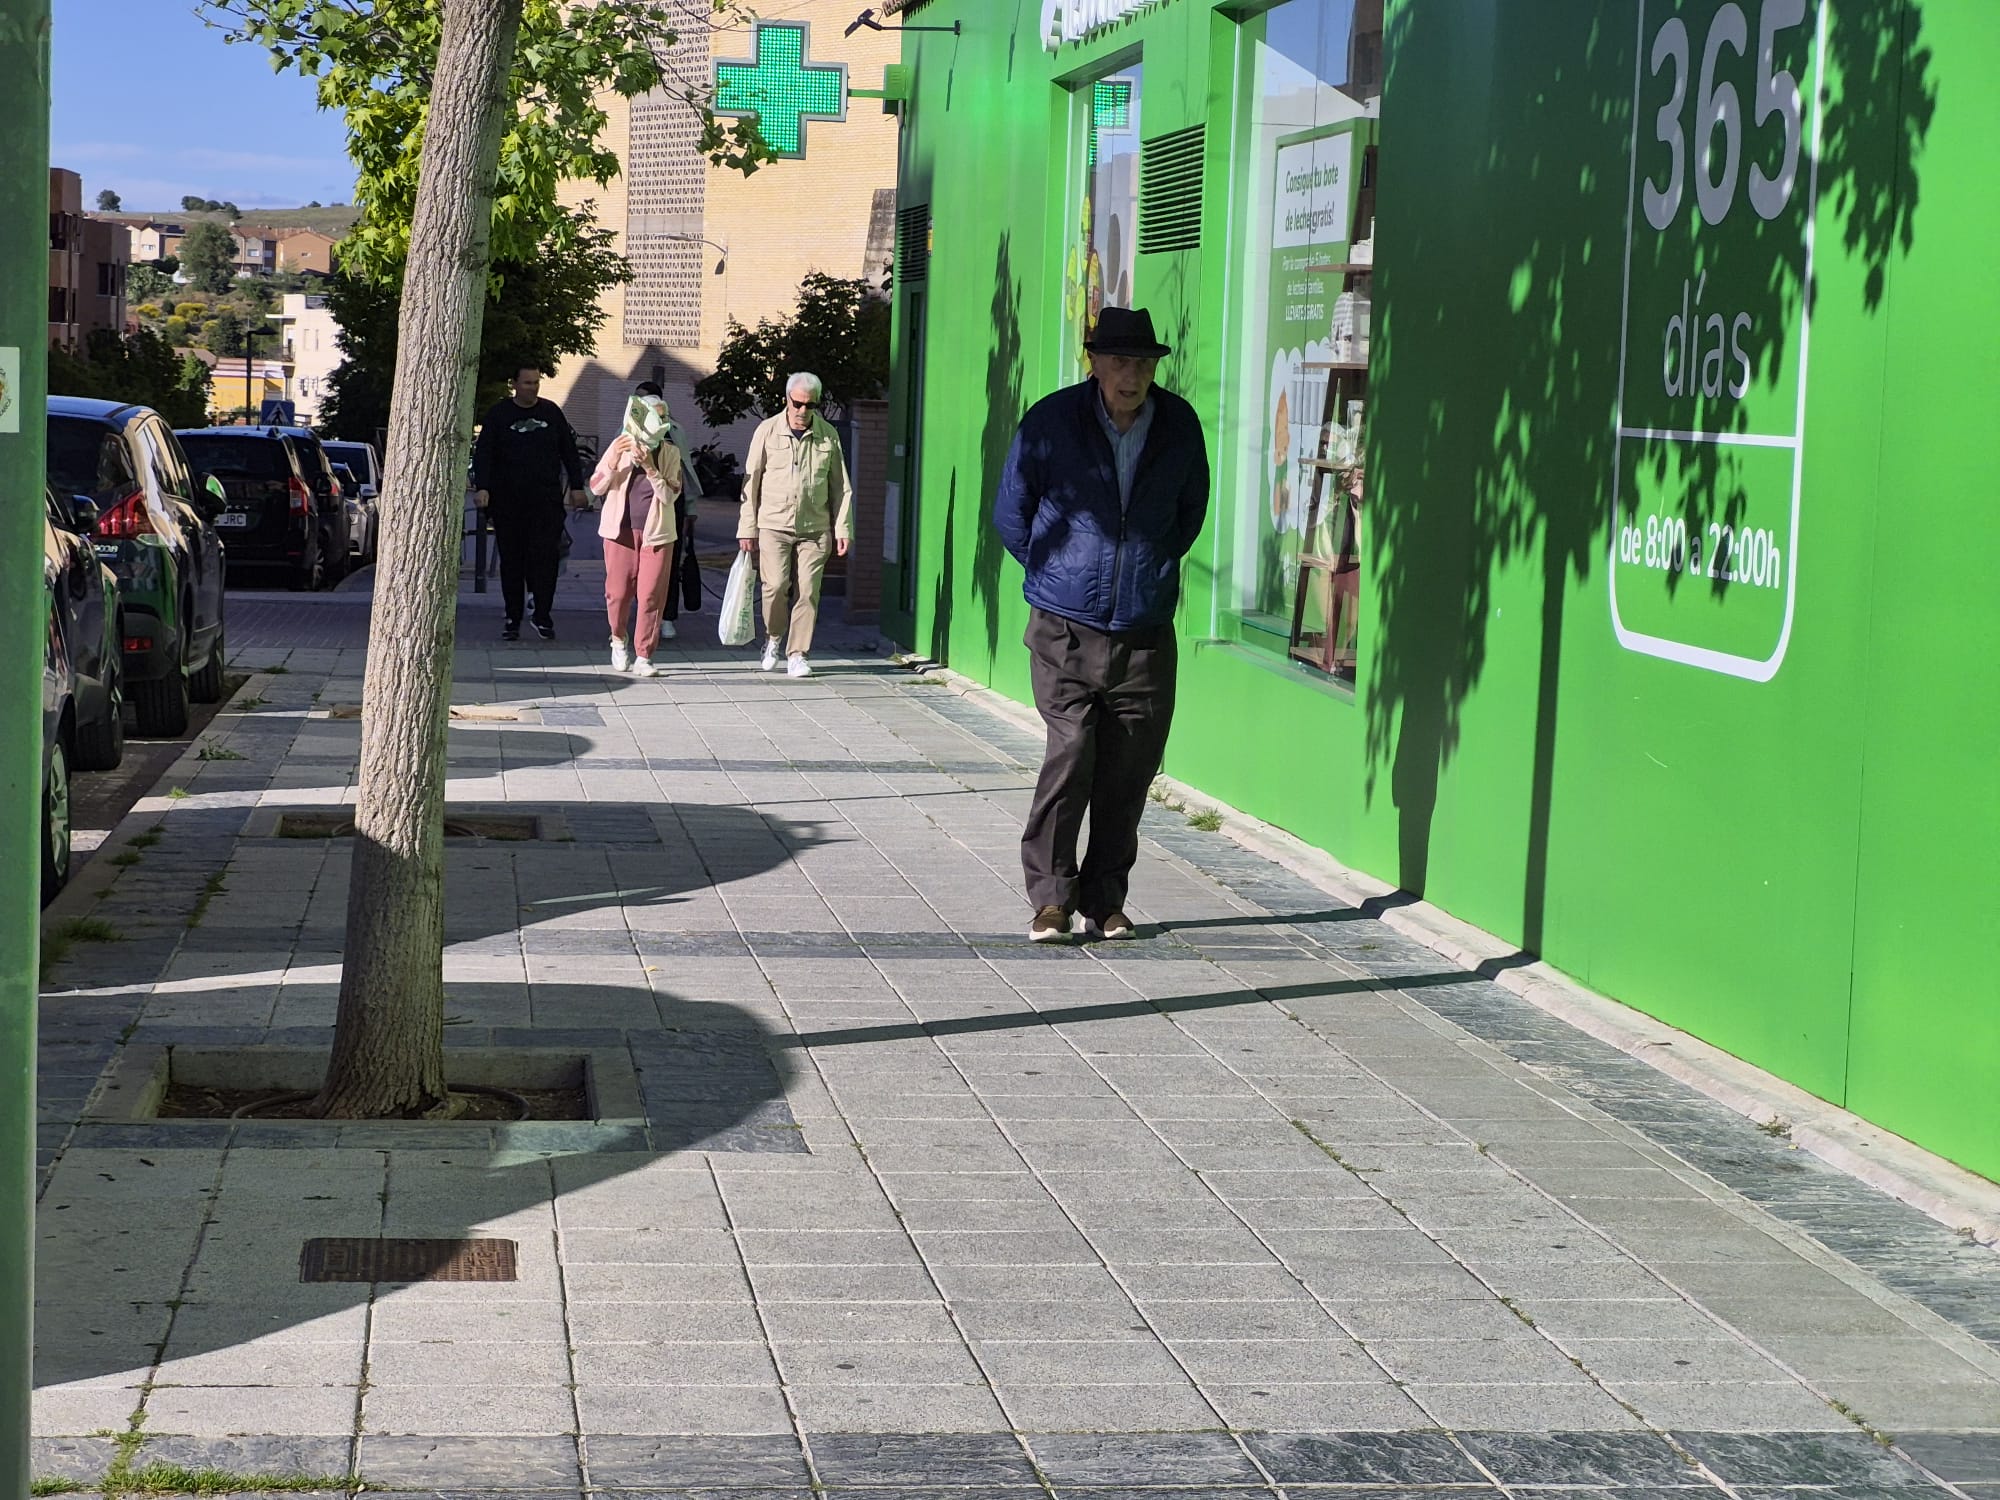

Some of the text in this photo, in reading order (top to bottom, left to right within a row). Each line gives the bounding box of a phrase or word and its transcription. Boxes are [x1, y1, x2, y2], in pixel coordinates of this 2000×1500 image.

[1643, 0, 1806, 231] 365
[1286, 160, 1338, 197] Consigue tu bote
[1285, 208, 1293, 232] de
[1312, 200, 1335, 234] gratis!
[1664, 268, 1752, 399] días
[223, 514, 244, 525] JRC
[1620, 512, 1781, 589] de 8:00 a 22:00h
